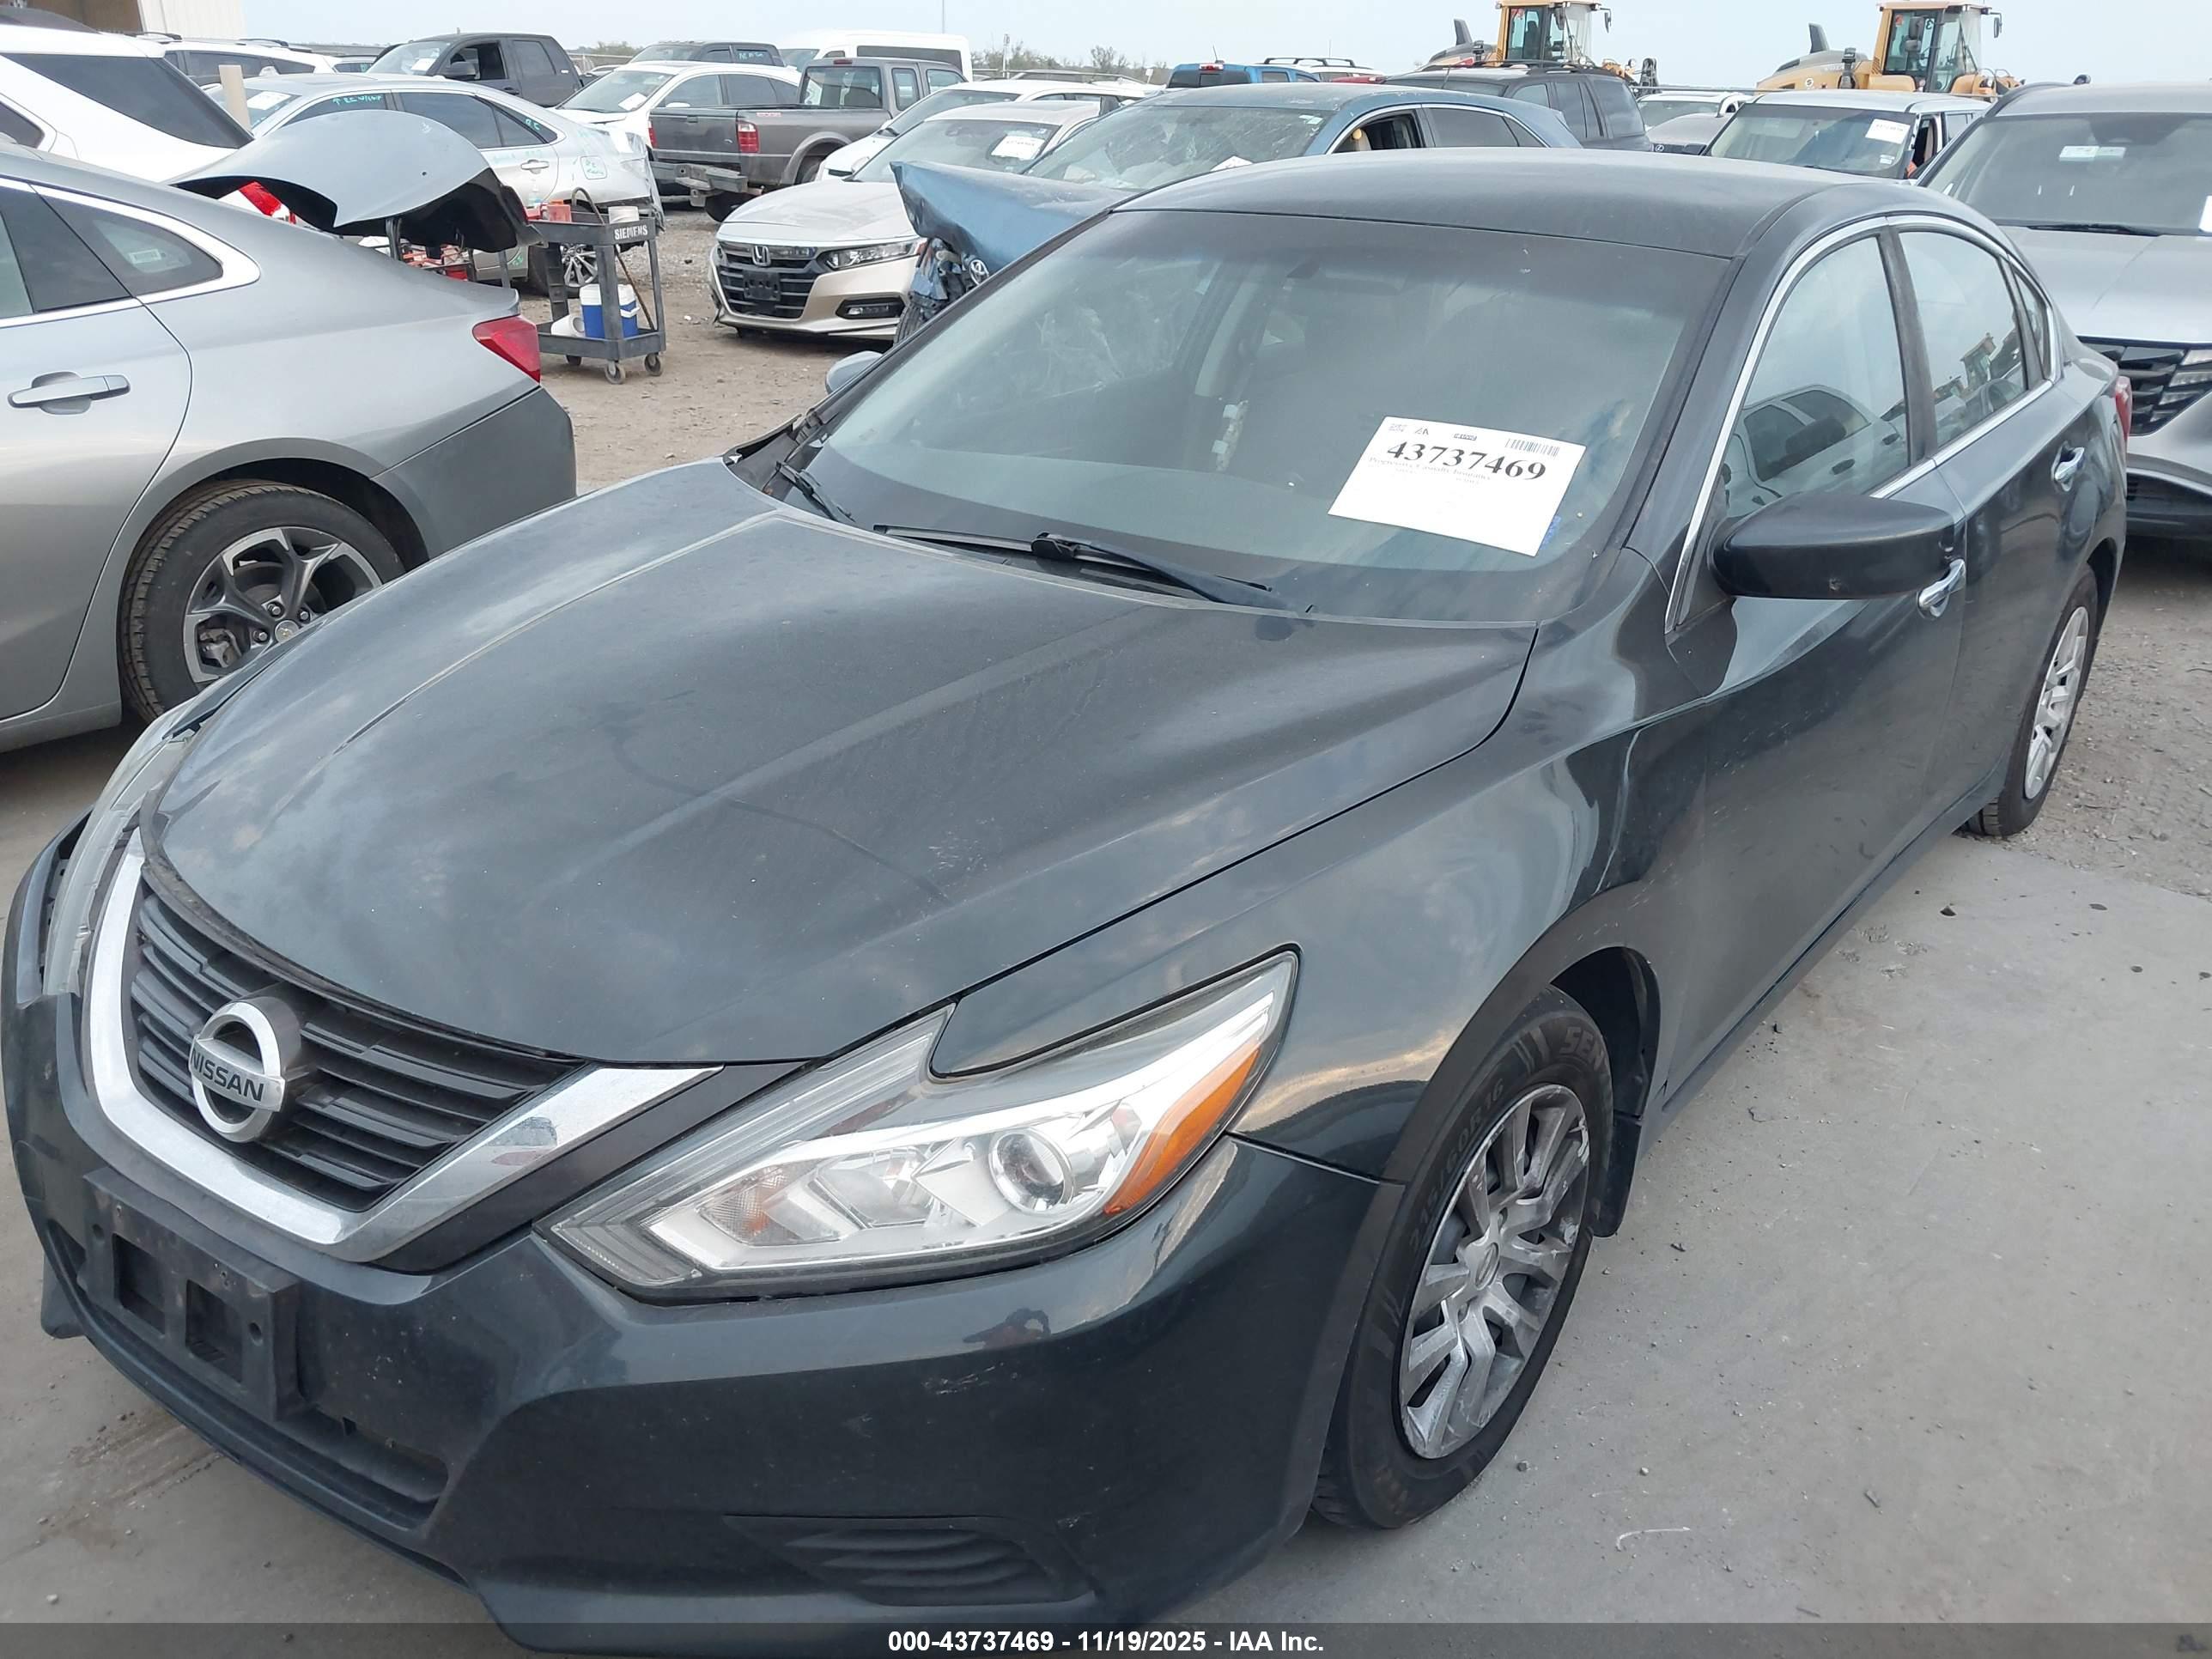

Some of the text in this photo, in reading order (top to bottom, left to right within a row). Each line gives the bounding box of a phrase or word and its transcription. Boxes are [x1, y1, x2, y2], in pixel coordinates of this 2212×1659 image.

[614, 225, 648, 240] SIEMENS
[1387, 441, 1547, 480] 43737469
[191, 1048, 264, 1102] NISSAN
